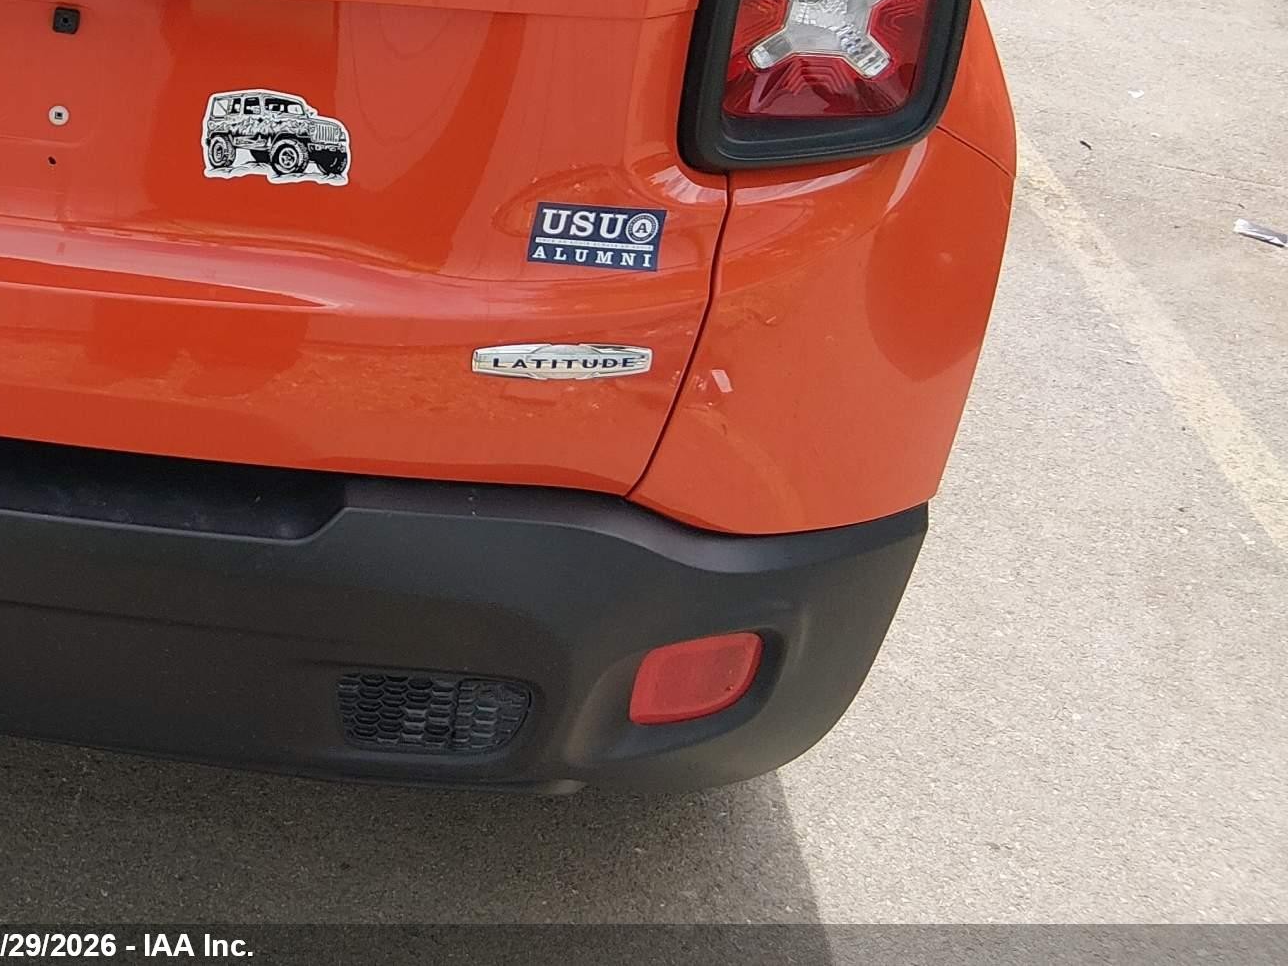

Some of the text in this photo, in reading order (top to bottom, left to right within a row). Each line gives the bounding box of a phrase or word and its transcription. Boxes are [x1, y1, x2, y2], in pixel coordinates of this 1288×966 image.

[542, 208, 628, 239] USU
[532, 245, 652, 268] ALUMNI
[492, 357, 635, 370] LATITUDE
